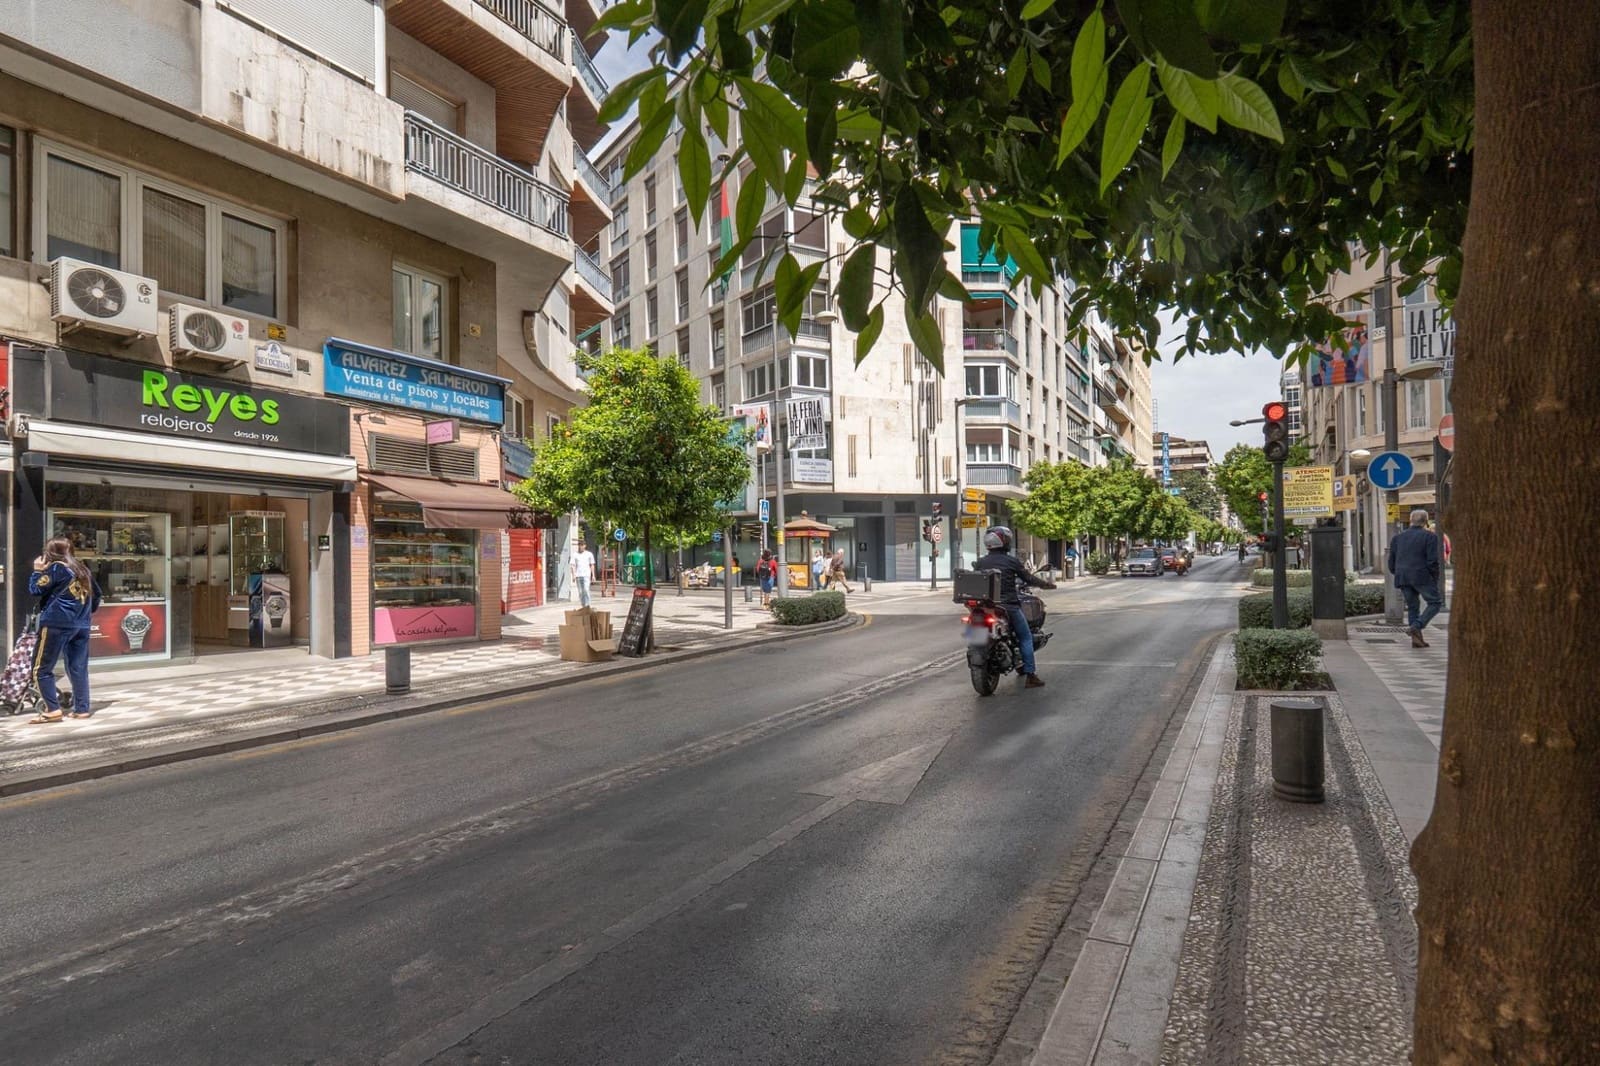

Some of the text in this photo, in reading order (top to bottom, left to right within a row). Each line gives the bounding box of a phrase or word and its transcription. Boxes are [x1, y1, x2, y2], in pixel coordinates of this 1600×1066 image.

[138, 296, 150, 304] LG
[1410, 310, 1426, 336] LA
[1410, 334, 1434, 360] DEL
[256, 356, 290, 370] RECOGIDAS
[341, 352, 489, 396] ALVAREZ SALMERON
[142, 370, 280, 425] Reyes
[342, 368, 490, 410] Venta de pisos y locales
[788, 400, 822, 420] LA FERIA
[140, 412, 214, 434] relojeros
[790, 416, 824, 436] DEL VINO
[234, 430, 279, 442] desde 1926
[396, 627, 406, 636] La
[407, 626, 432, 636] casita
[432, 624, 443, 633] del
